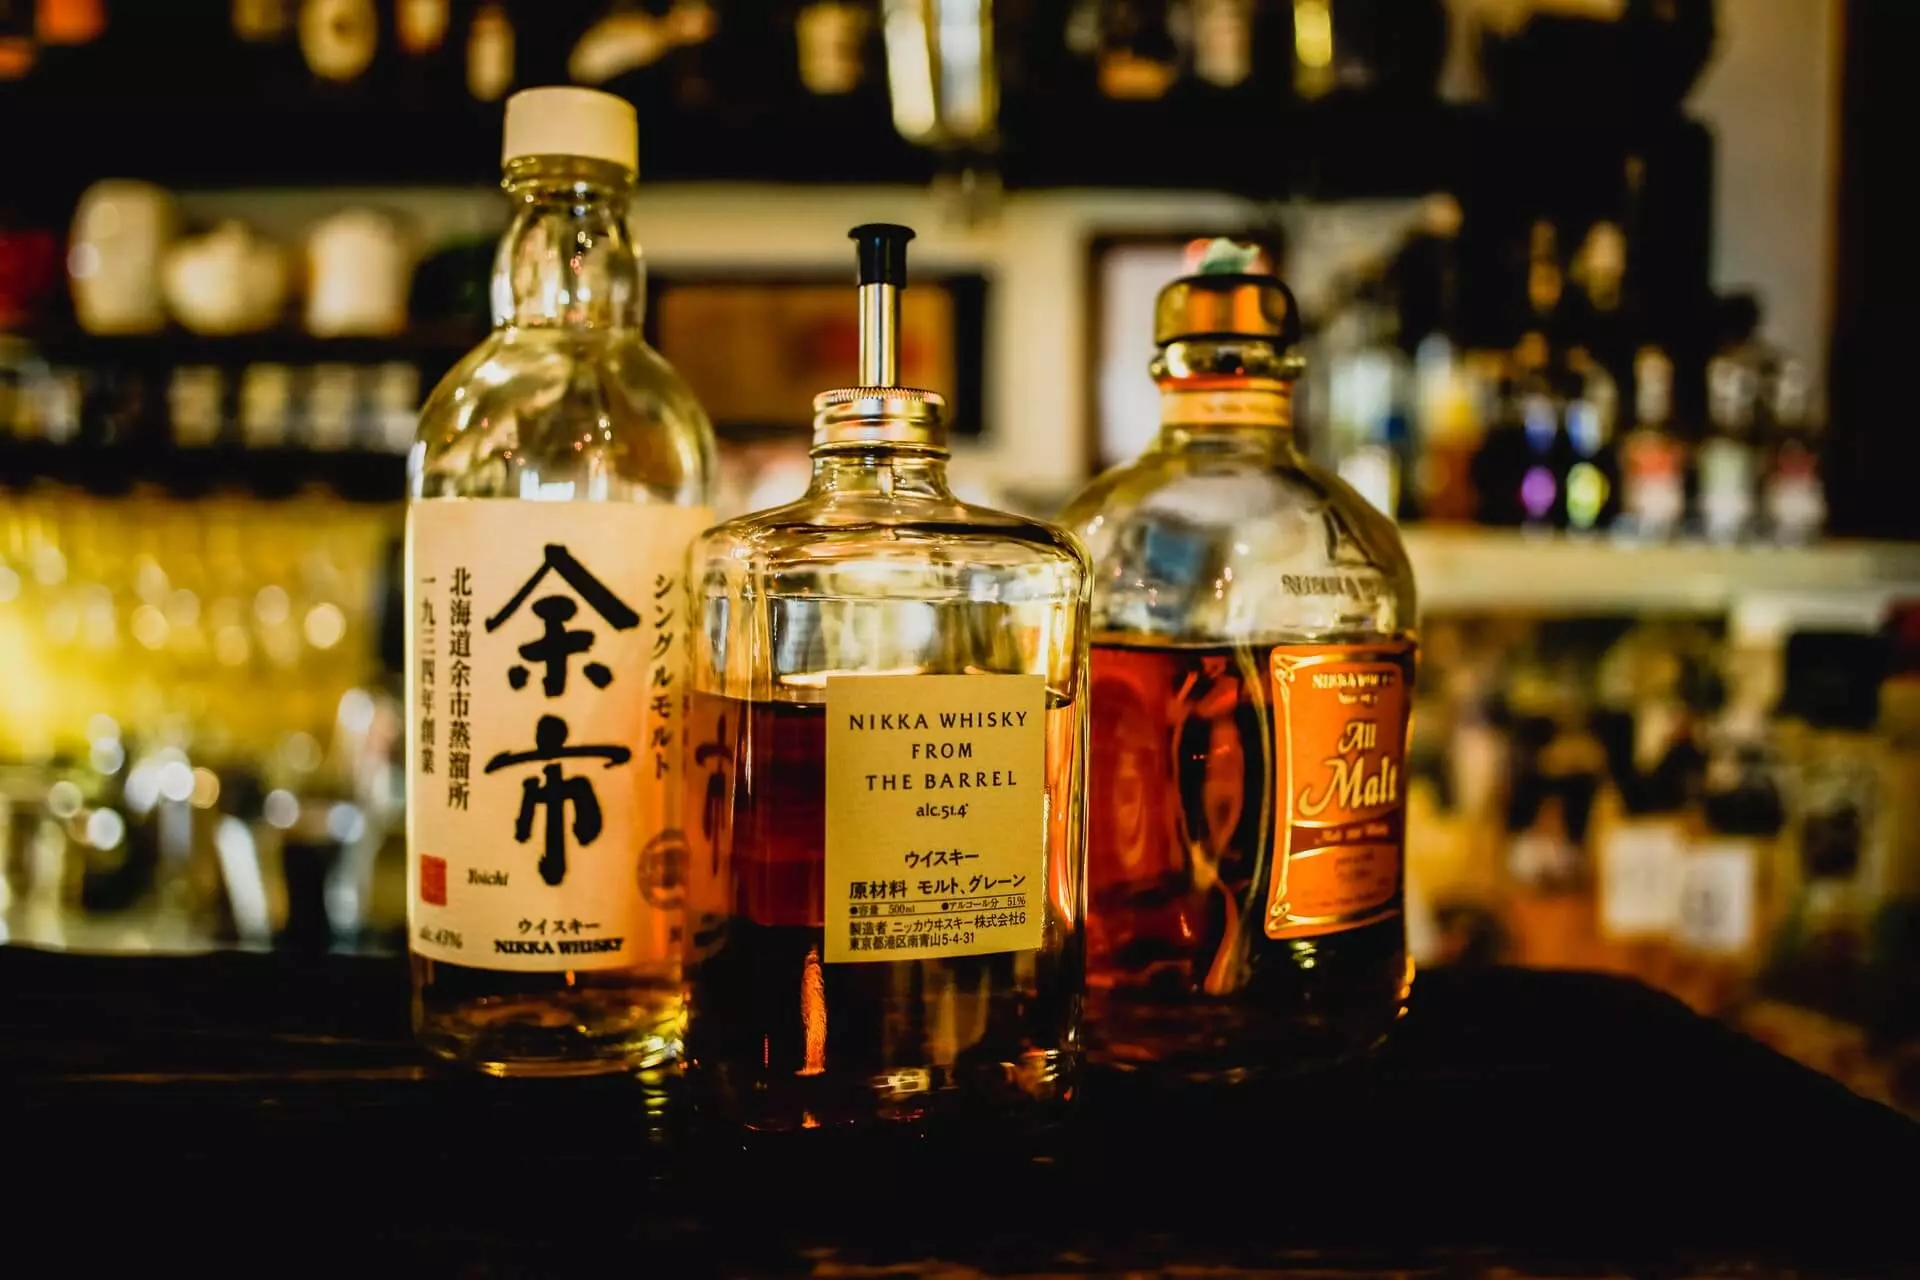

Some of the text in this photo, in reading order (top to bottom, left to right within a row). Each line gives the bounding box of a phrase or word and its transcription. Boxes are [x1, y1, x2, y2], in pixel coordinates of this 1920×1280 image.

[650, 573, 673, 780] シングルモルト
[484, 543, 641, 886] 余市
[849, 711, 1028, 730] NIKKA WHISKY
[1338, 721, 1377, 754] All
[911, 742, 973, 759] FROM
[865, 770, 1017, 791] THE BARREL
[1298, 756, 1398, 817] Malt
[904, 849, 980, 868] ウイスキー
[467, 868, 510, 886] Yoichi
[849, 874, 1026, 899] 原材料 モルト、グレーン
[518, 918, 601, 935] ウイスキー
[849, 921, 887, 936] 製造者
[494, 939, 555, 955] NIKKA
